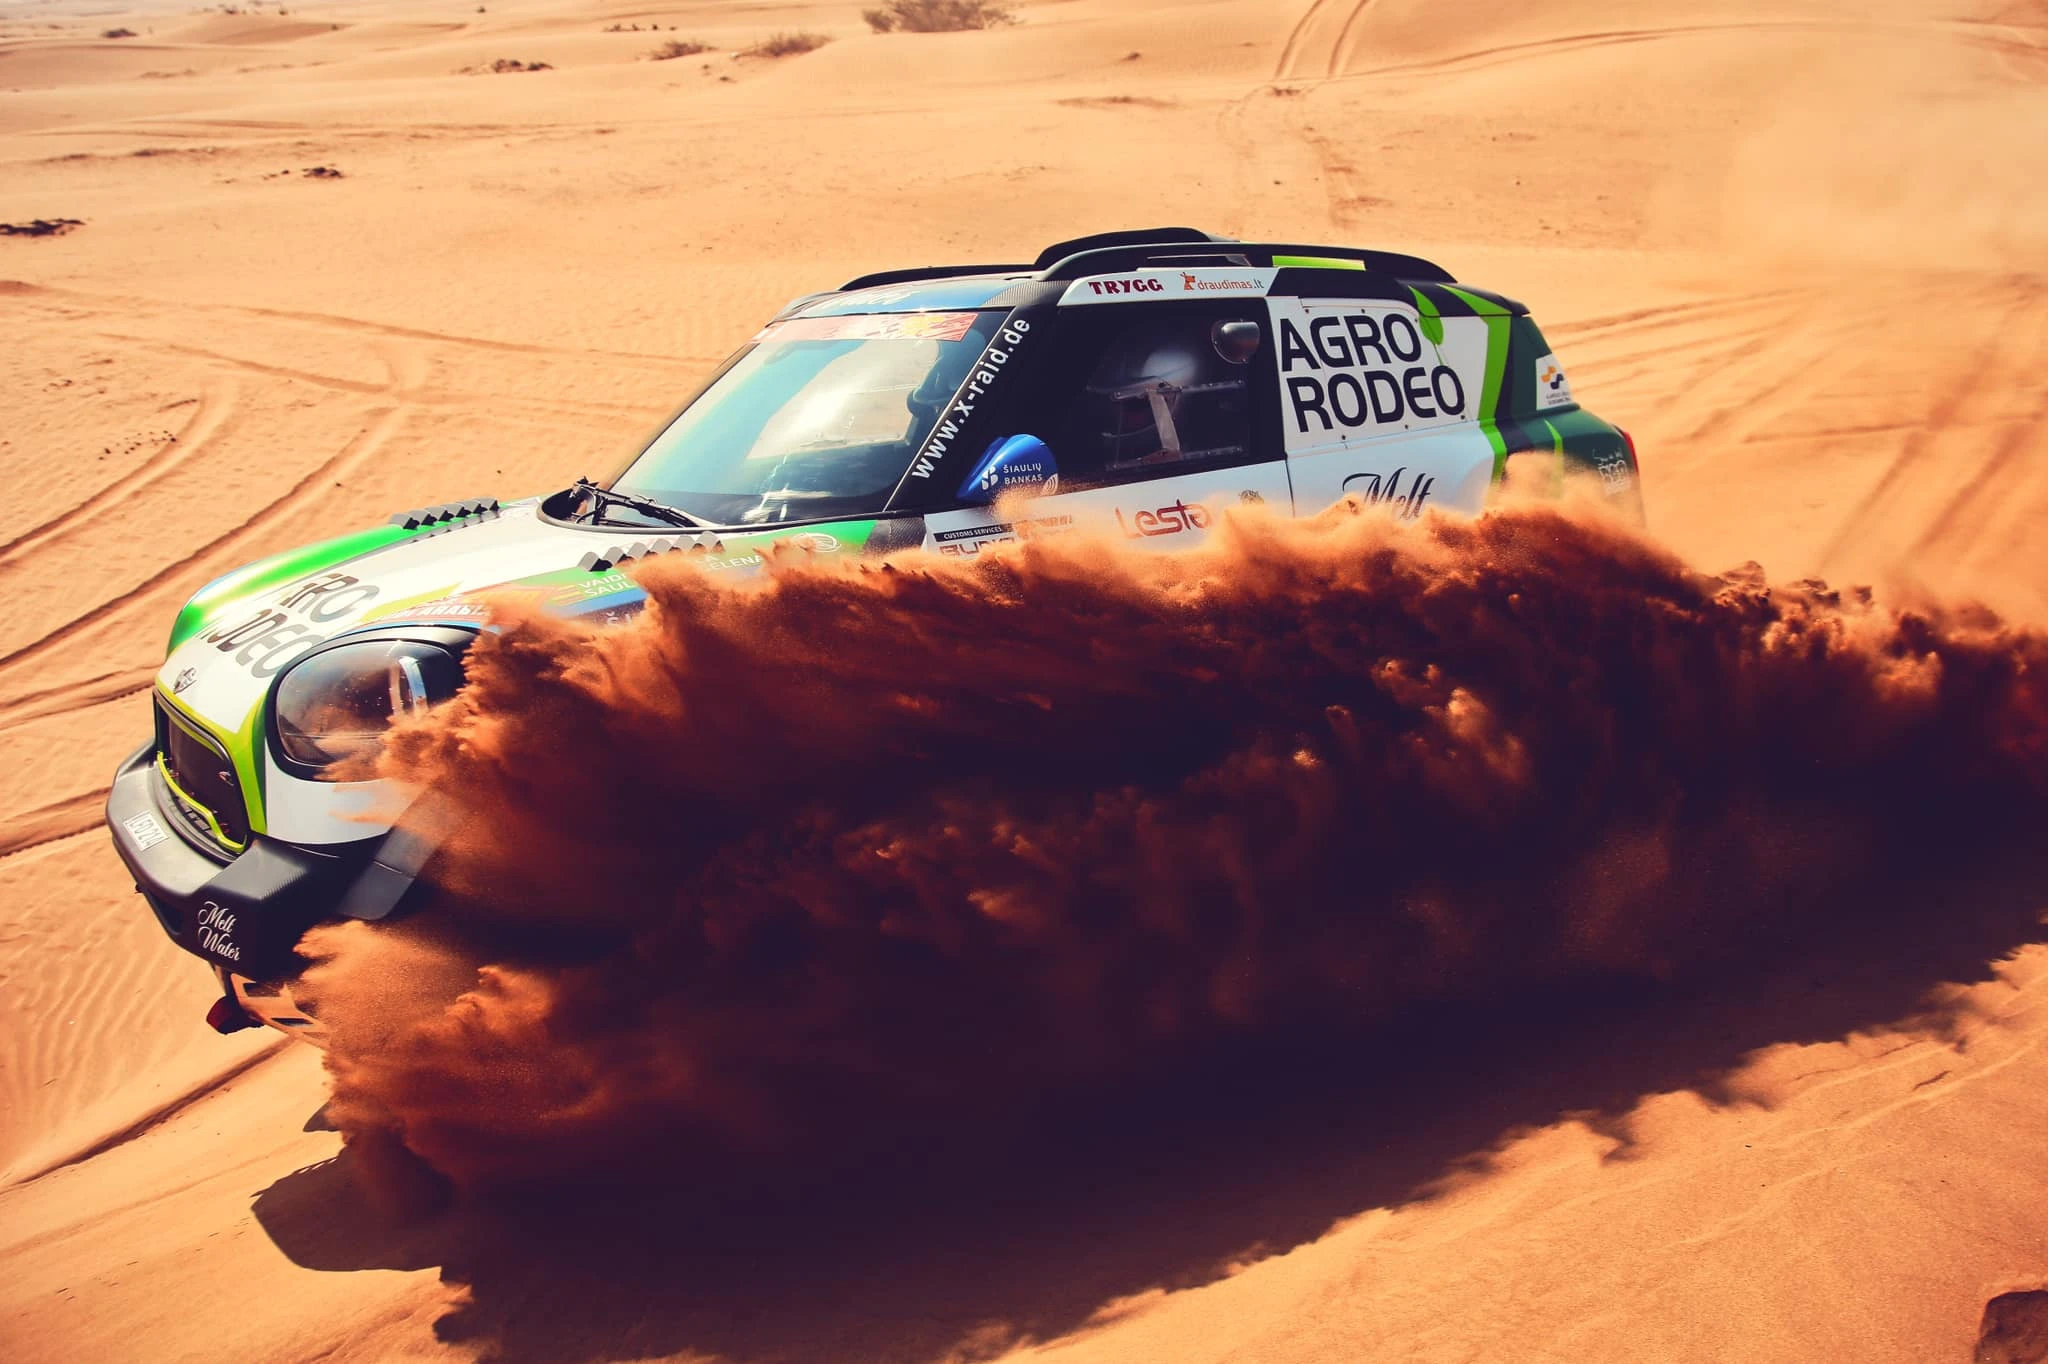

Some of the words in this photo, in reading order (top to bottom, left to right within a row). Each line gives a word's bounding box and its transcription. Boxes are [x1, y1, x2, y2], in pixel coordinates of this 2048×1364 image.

[1088, 278, 1164, 295] TRYGG
[1197, 279, 1265, 291] draudimas.lt
[1280, 313, 1422, 372] AGRO
[912, 319, 1031, 479] www.x-raid.de
[1287, 365, 1465, 433] RODEO
[1003, 463, 1042, 474] ŠIAULIŲ
[1004, 474, 1043, 485] BANKAS
[943, 529, 974, 540] CUSTOMS
[973, 526, 1002, 535] SERVICES
[198, 901, 237, 933] Melt
[198, 926, 241, 961] Water
